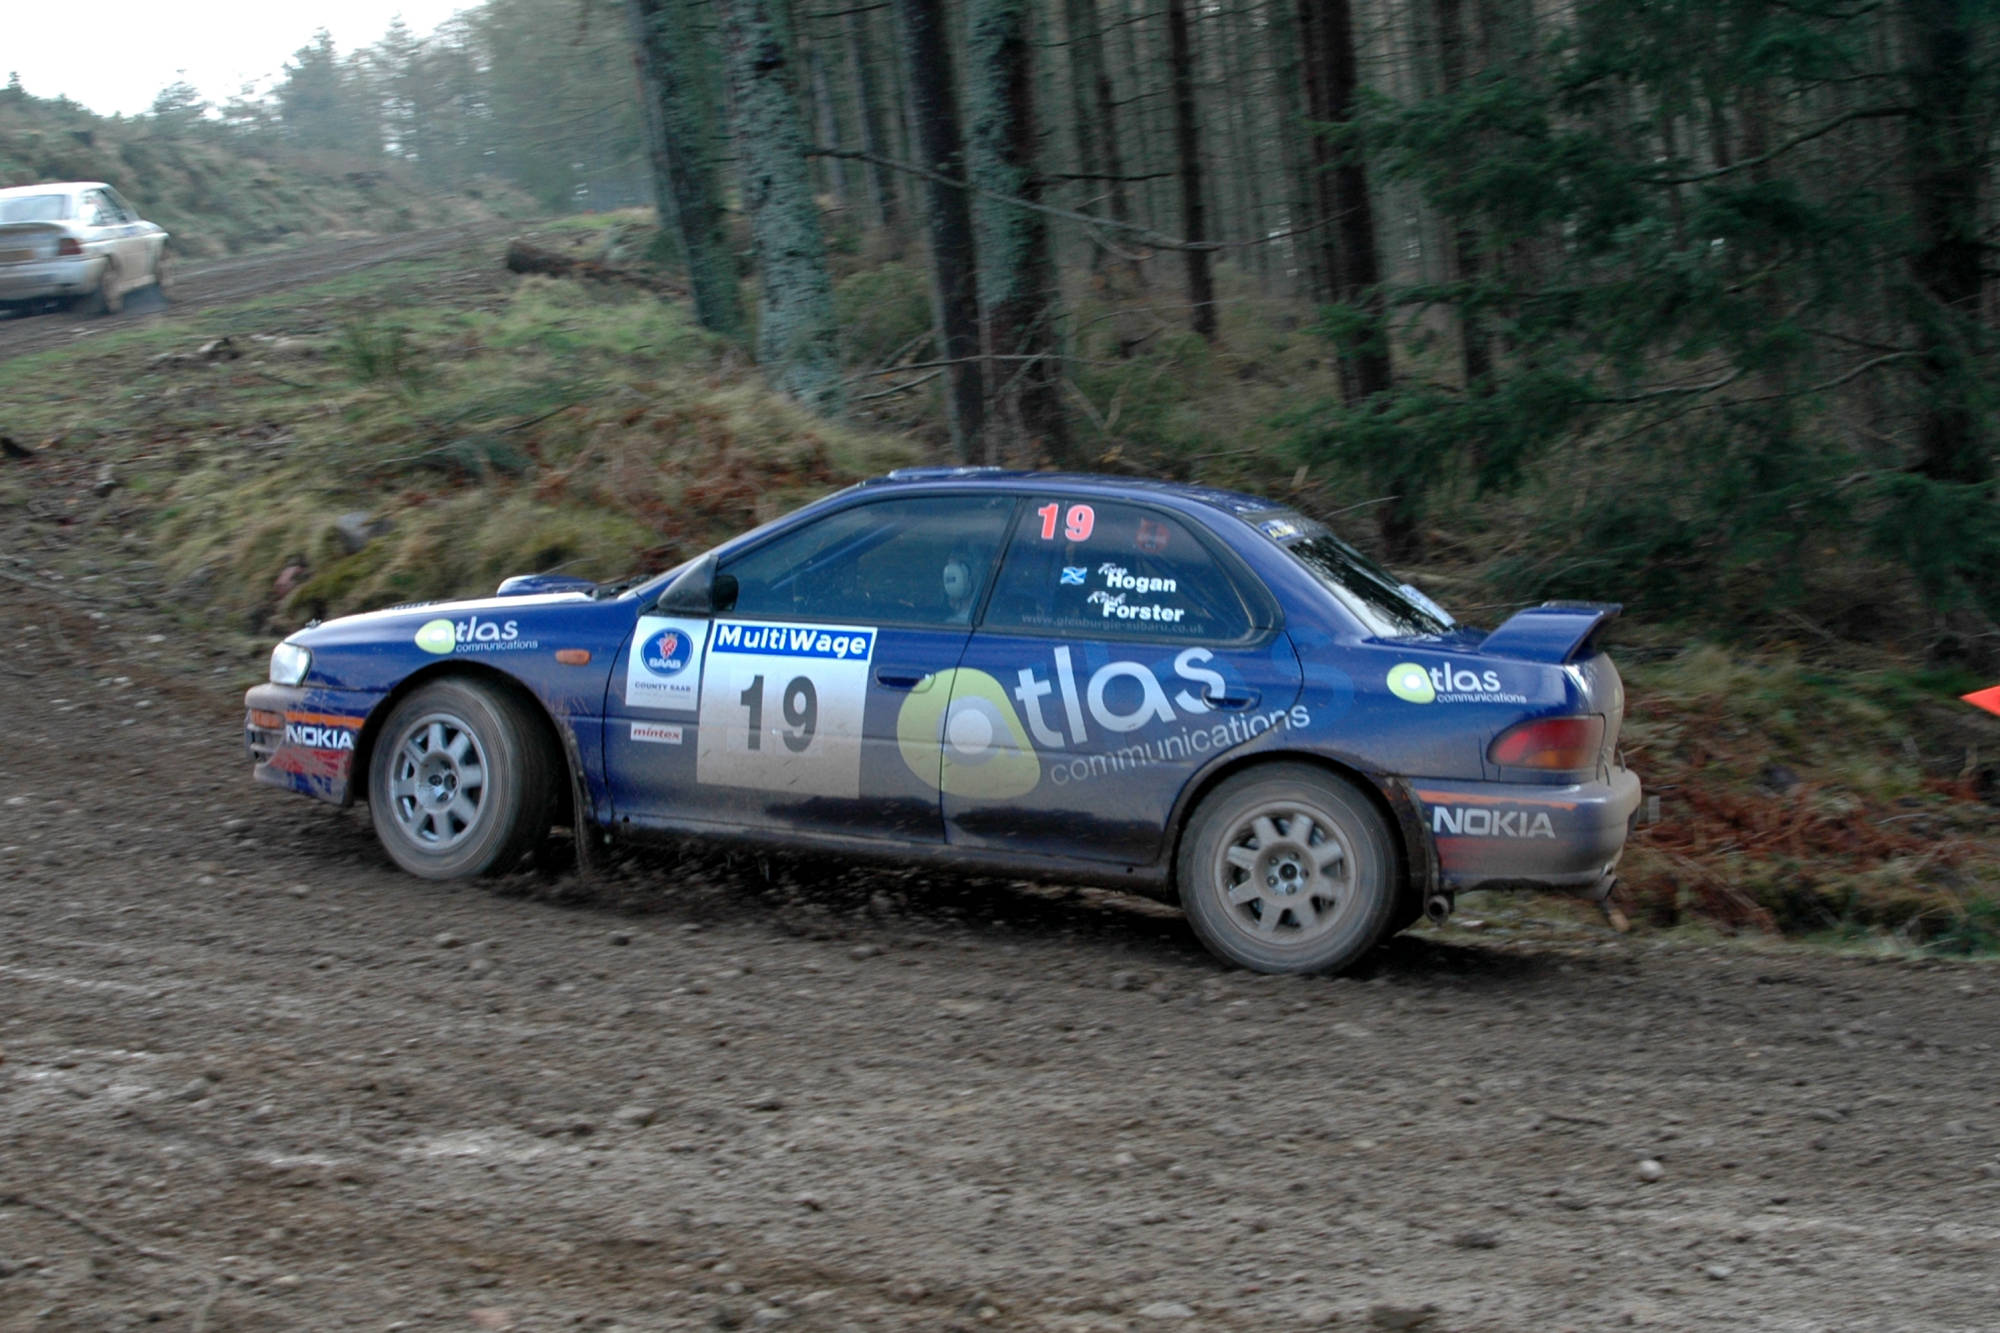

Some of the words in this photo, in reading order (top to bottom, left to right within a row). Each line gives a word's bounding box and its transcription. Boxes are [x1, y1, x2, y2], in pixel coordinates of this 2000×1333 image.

[1038, 503, 1095, 541] 19
[1106, 571, 1177, 593] Hogan
[1102, 600, 1185, 622] Forster
[455, 639, 538, 653] communications
[717, 625, 866, 658] MultiWage
[649, 657, 682, 669] SAAB
[635, 681, 667, 690] COUNTY
[1437, 691, 1527, 704] communications
[740, 674, 818, 753] 19
[285, 725, 355, 750] NOKIA
[633, 727, 680, 741] mintex
[1050, 702, 1310, 787] communications
[1432, 806, 1556, 839] NOKIA
